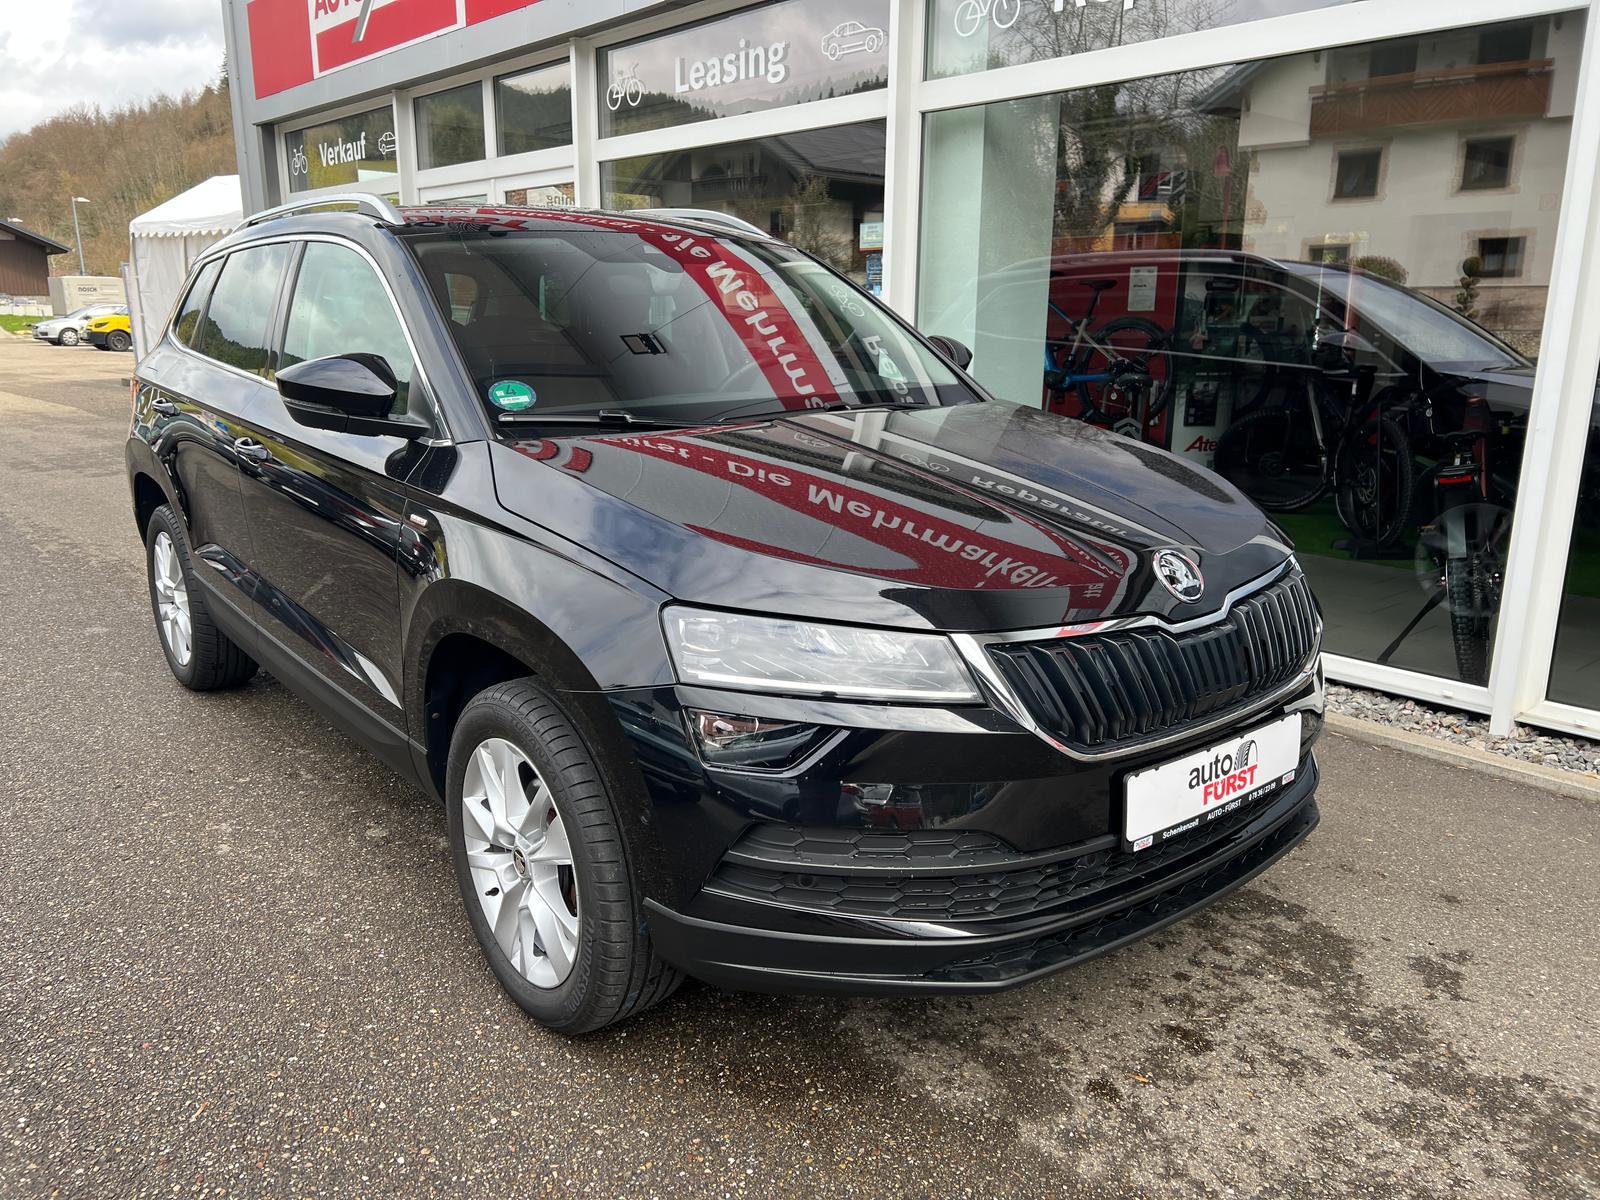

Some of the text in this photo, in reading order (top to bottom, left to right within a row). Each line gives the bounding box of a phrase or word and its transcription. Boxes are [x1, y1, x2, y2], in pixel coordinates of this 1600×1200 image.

[674, 38, 786, 93] Leasing
[319, 131, 366, 167] Verkauf
[1188, 754, 1233, 790] auto
[1203, 764, 1258, 806] FÜRST
[1162, 818, 1199, 839] Schenkenzell
